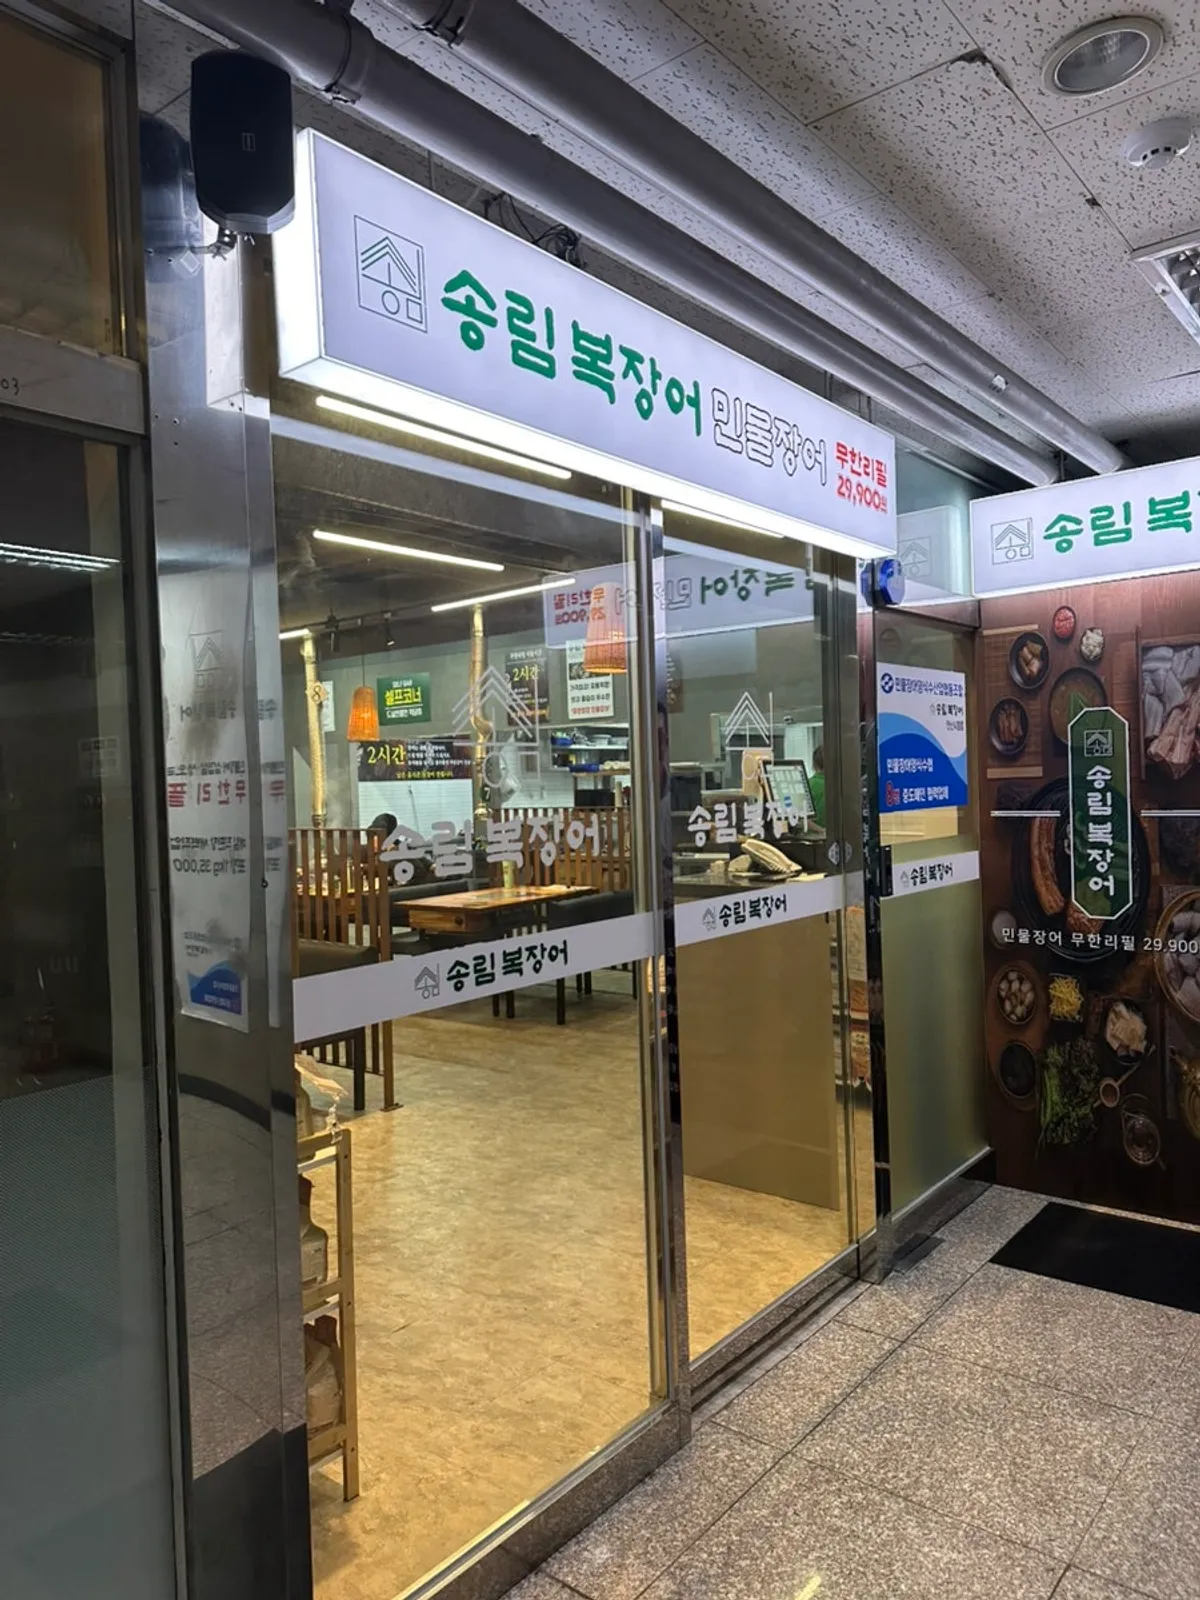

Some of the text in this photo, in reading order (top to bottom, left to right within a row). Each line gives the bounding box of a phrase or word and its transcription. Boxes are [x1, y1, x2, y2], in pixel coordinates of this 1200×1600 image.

[710, 387, 827, 486] 민물장어
[835, 441, 888, 488] 무한리필
[1146, 489, 1200, 534] 복
[366, 744, 407, 766] 2시간
[1001, 926, 1063, 947] 민물장어
[1070, 932, 1136, 952] 무한리필
